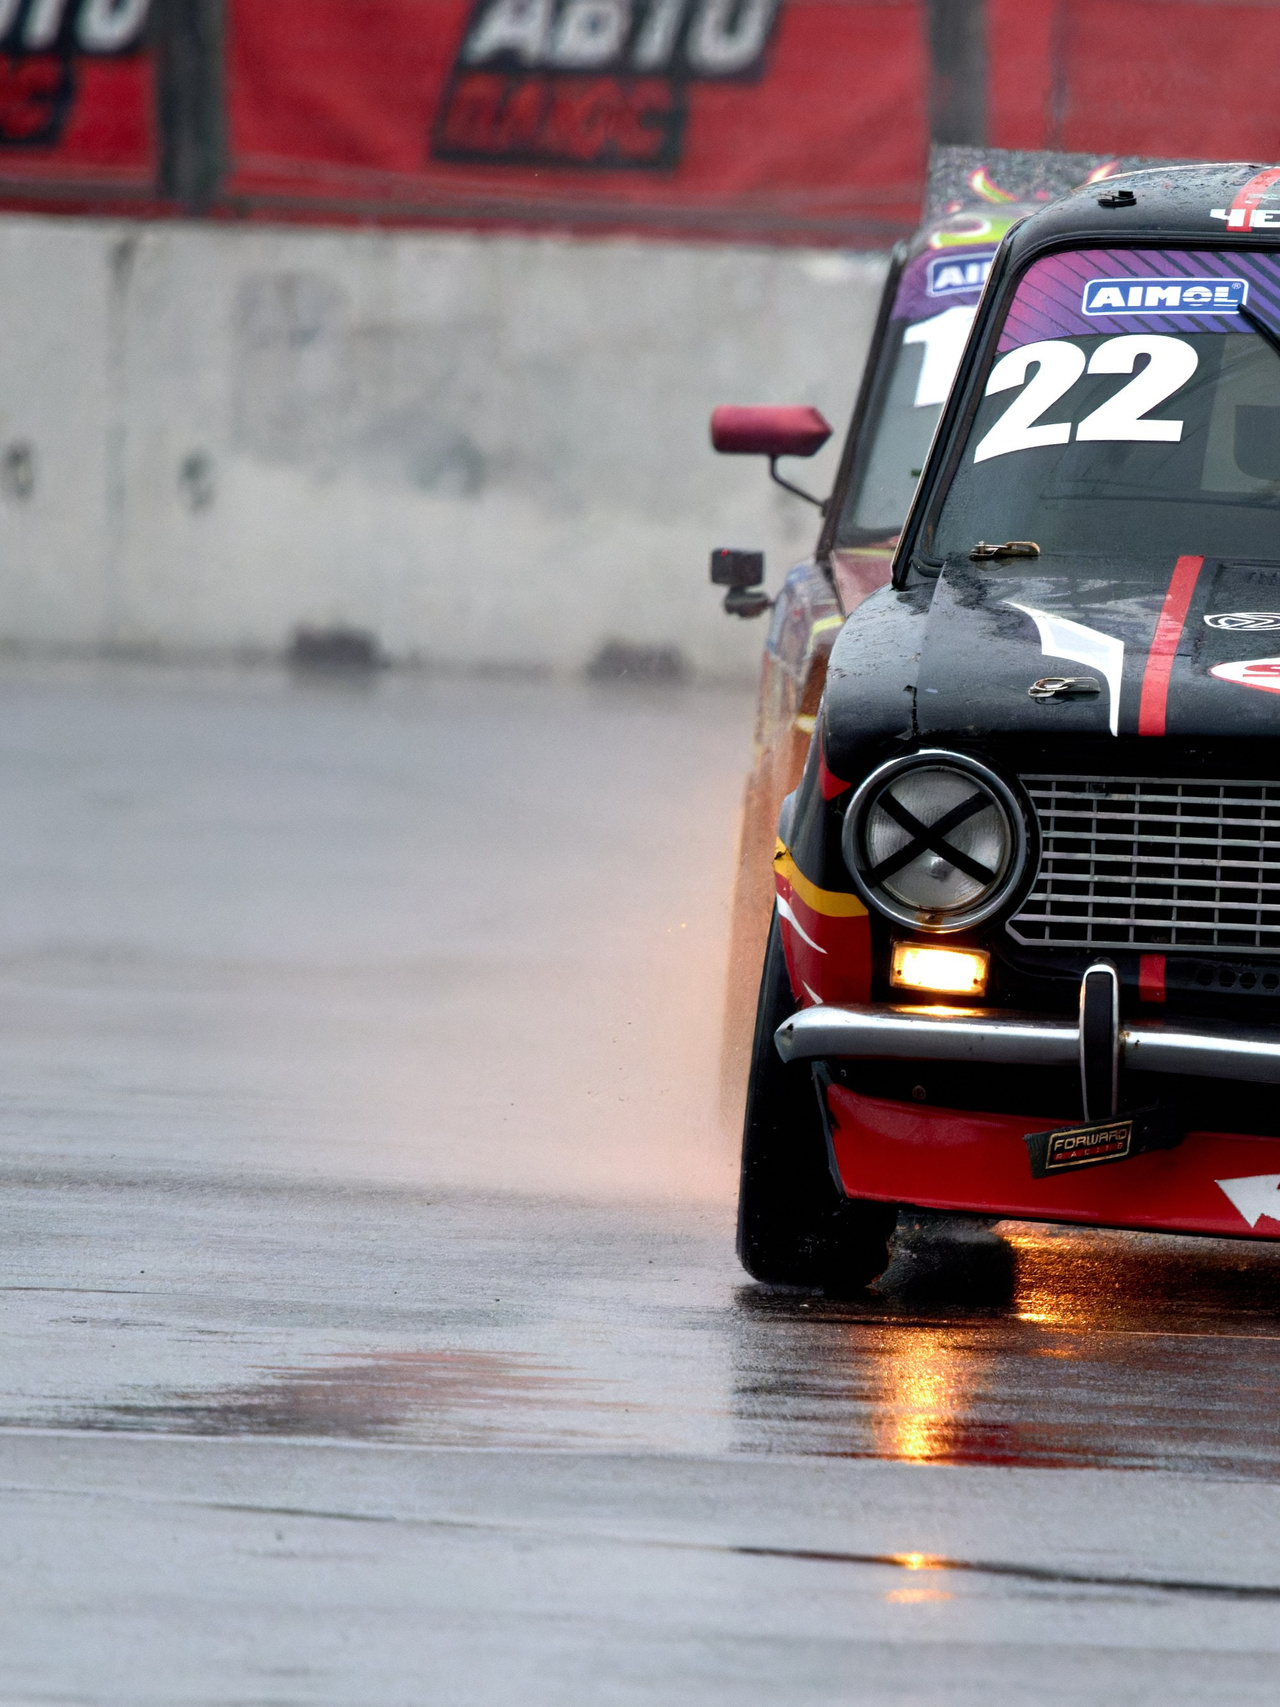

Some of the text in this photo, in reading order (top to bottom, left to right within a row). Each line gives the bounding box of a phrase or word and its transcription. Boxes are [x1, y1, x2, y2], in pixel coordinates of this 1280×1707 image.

[1088, 286, 1239, 308] AIMOL
[973, 334, 1199, 464] 22
[1055, 1130, 1127, 1150] FORWARD
